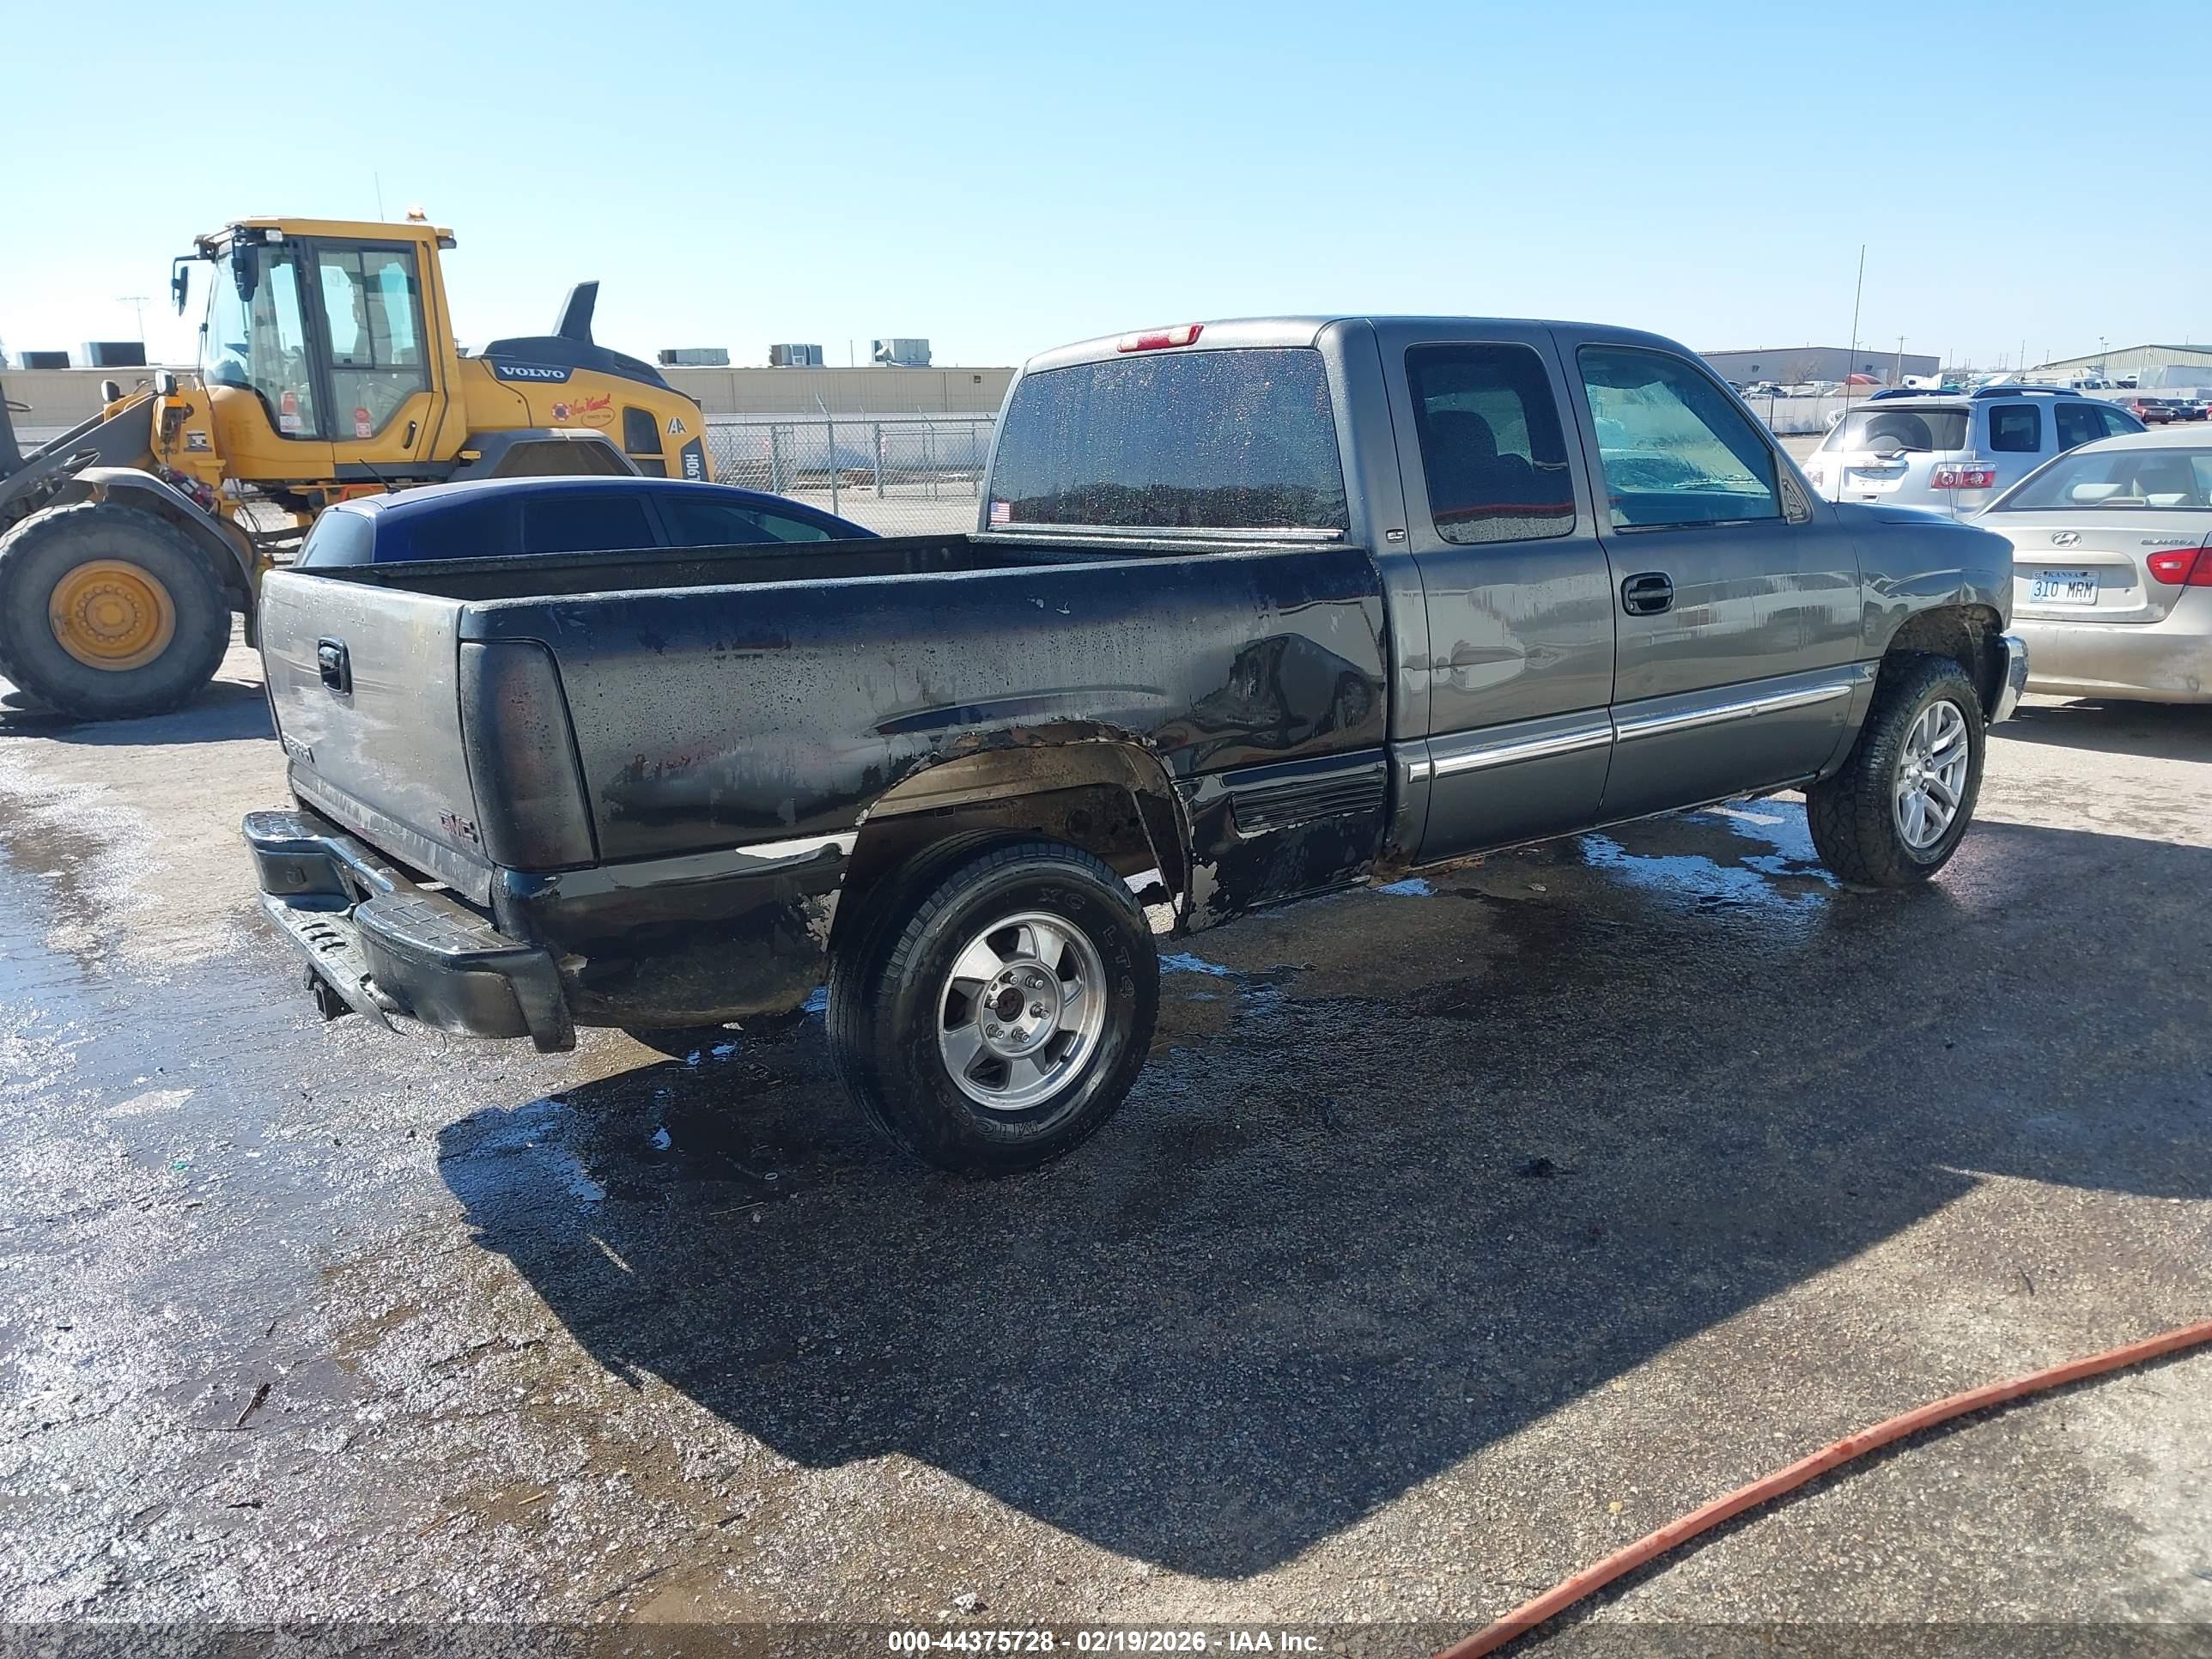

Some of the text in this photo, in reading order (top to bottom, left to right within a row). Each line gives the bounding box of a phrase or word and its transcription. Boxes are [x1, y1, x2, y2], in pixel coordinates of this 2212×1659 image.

[499, 366, 566, 379] VOLVO
[2033, 581, 2094, 599] 310 MRM
[439, 809, 478, 843] GMC
